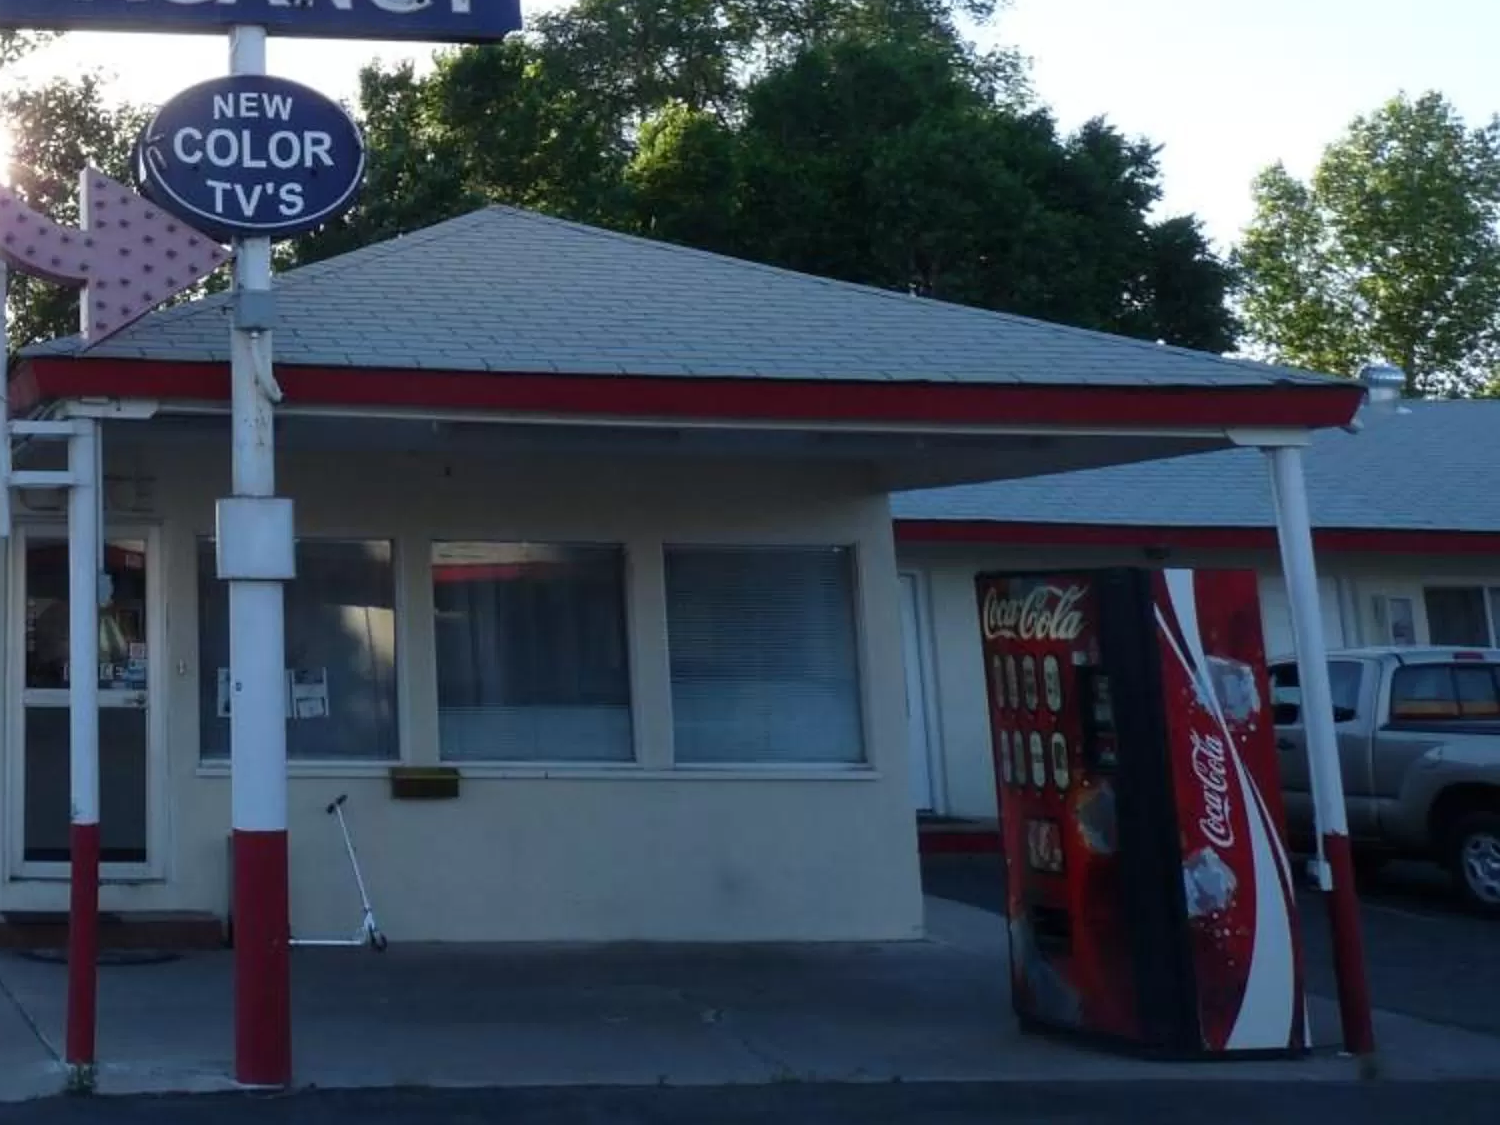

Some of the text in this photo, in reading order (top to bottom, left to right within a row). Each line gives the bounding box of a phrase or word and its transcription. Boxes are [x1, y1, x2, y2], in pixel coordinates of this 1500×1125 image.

[213, 92, 293, 121] NEW
[173, 127, 335, 169] COLOR
[206, 179, 305, 217] TV'S
